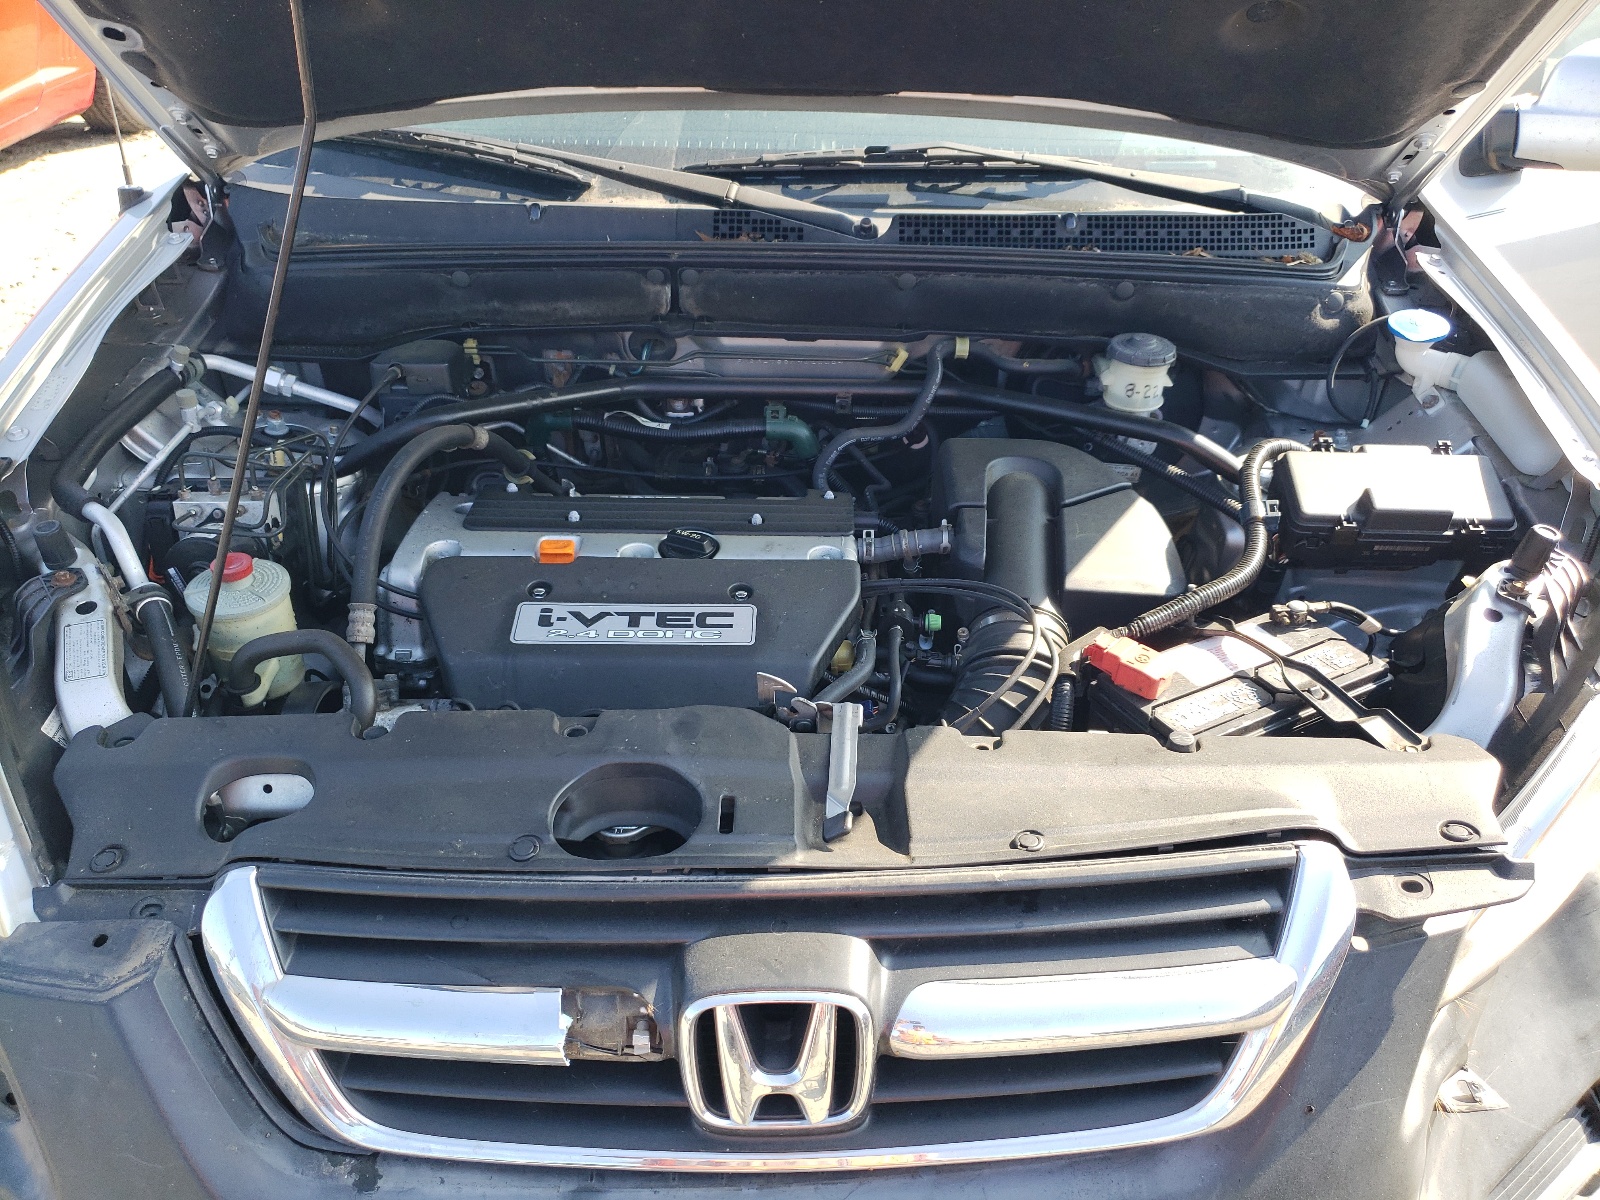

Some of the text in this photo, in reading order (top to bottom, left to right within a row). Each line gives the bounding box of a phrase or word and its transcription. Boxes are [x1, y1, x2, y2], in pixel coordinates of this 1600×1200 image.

[537, 607, 735, 629] i-VTEC
[546, 629, 722, 640] 2.4 DOHC
